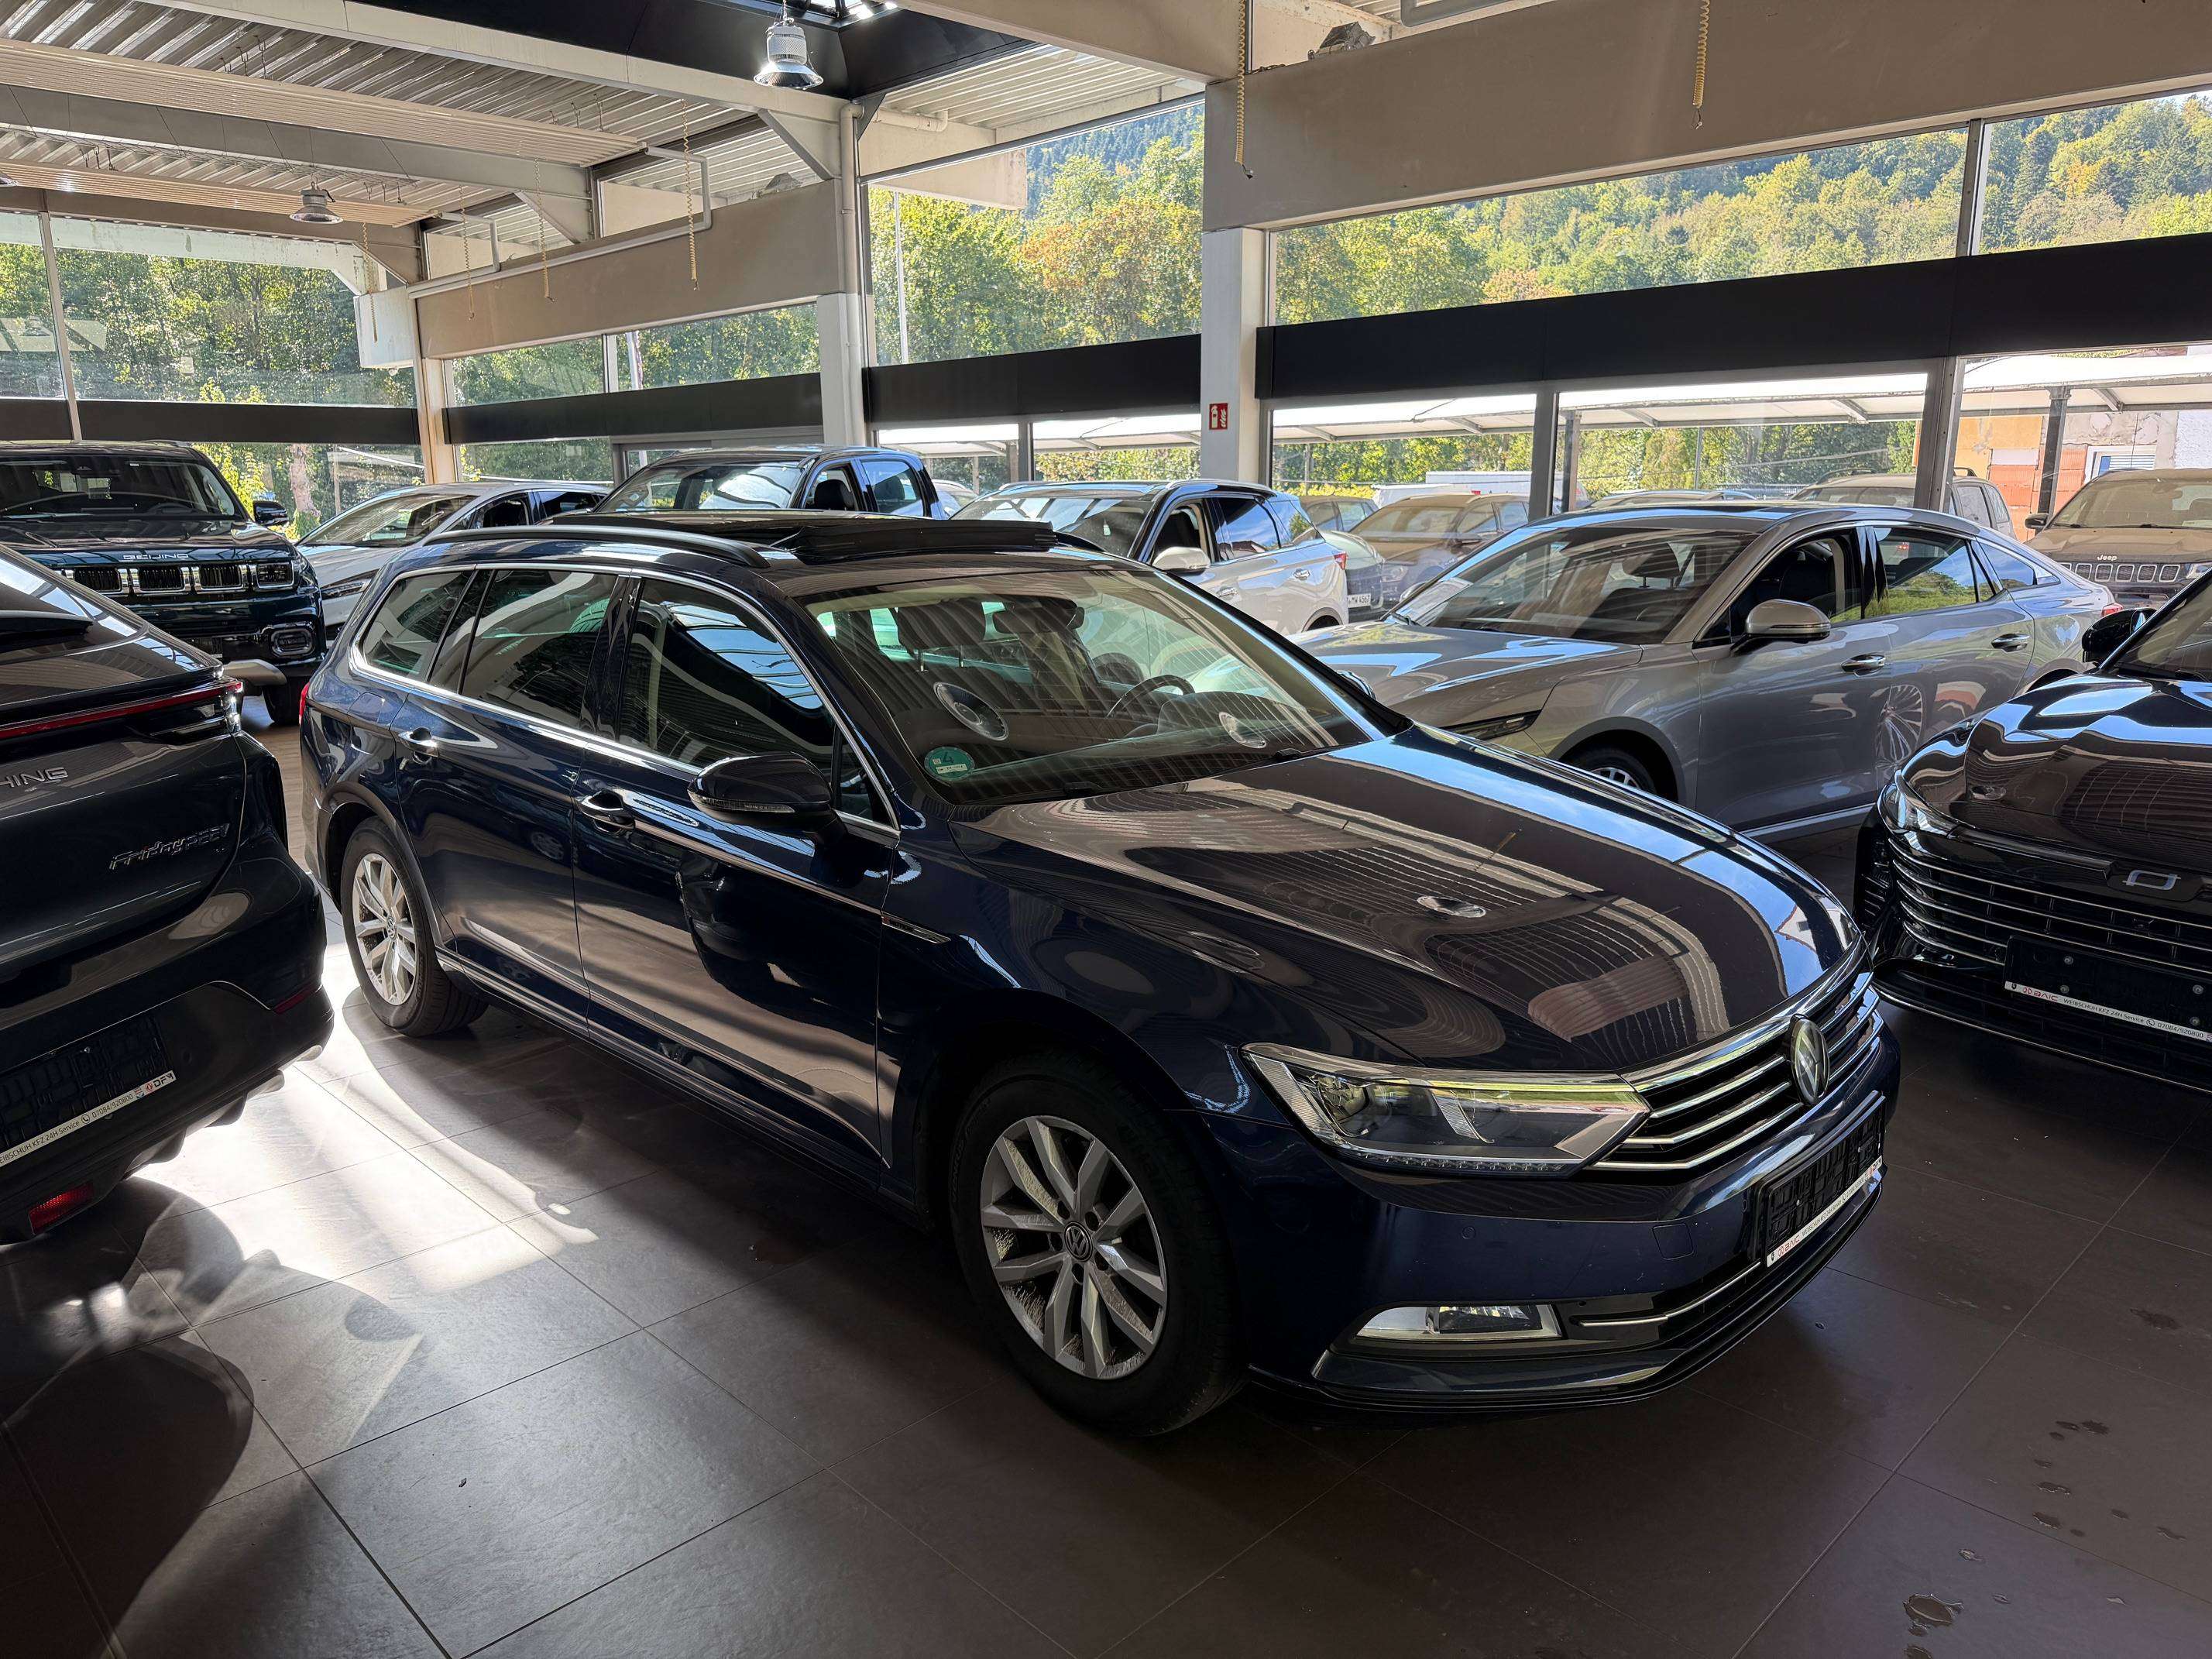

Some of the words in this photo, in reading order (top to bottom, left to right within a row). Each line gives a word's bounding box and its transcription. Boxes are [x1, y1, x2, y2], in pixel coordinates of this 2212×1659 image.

[2097, 554, 2118, 562] Jeep
[2034, 990, 2058, 1002] BAIC
[2098, 1007, 2110, 1015] KFZ
[2124, 1013, 2144, 1023] Service
[2157, 1022, 2204, 1039] 07084/920800
[32, 1136, 45, 1149] KFZ
[45, 1130, 59, 1142] 24H
[59, 1121, 80, 1135] Service
[91, 1094, 134, 1118] 07084/920800
